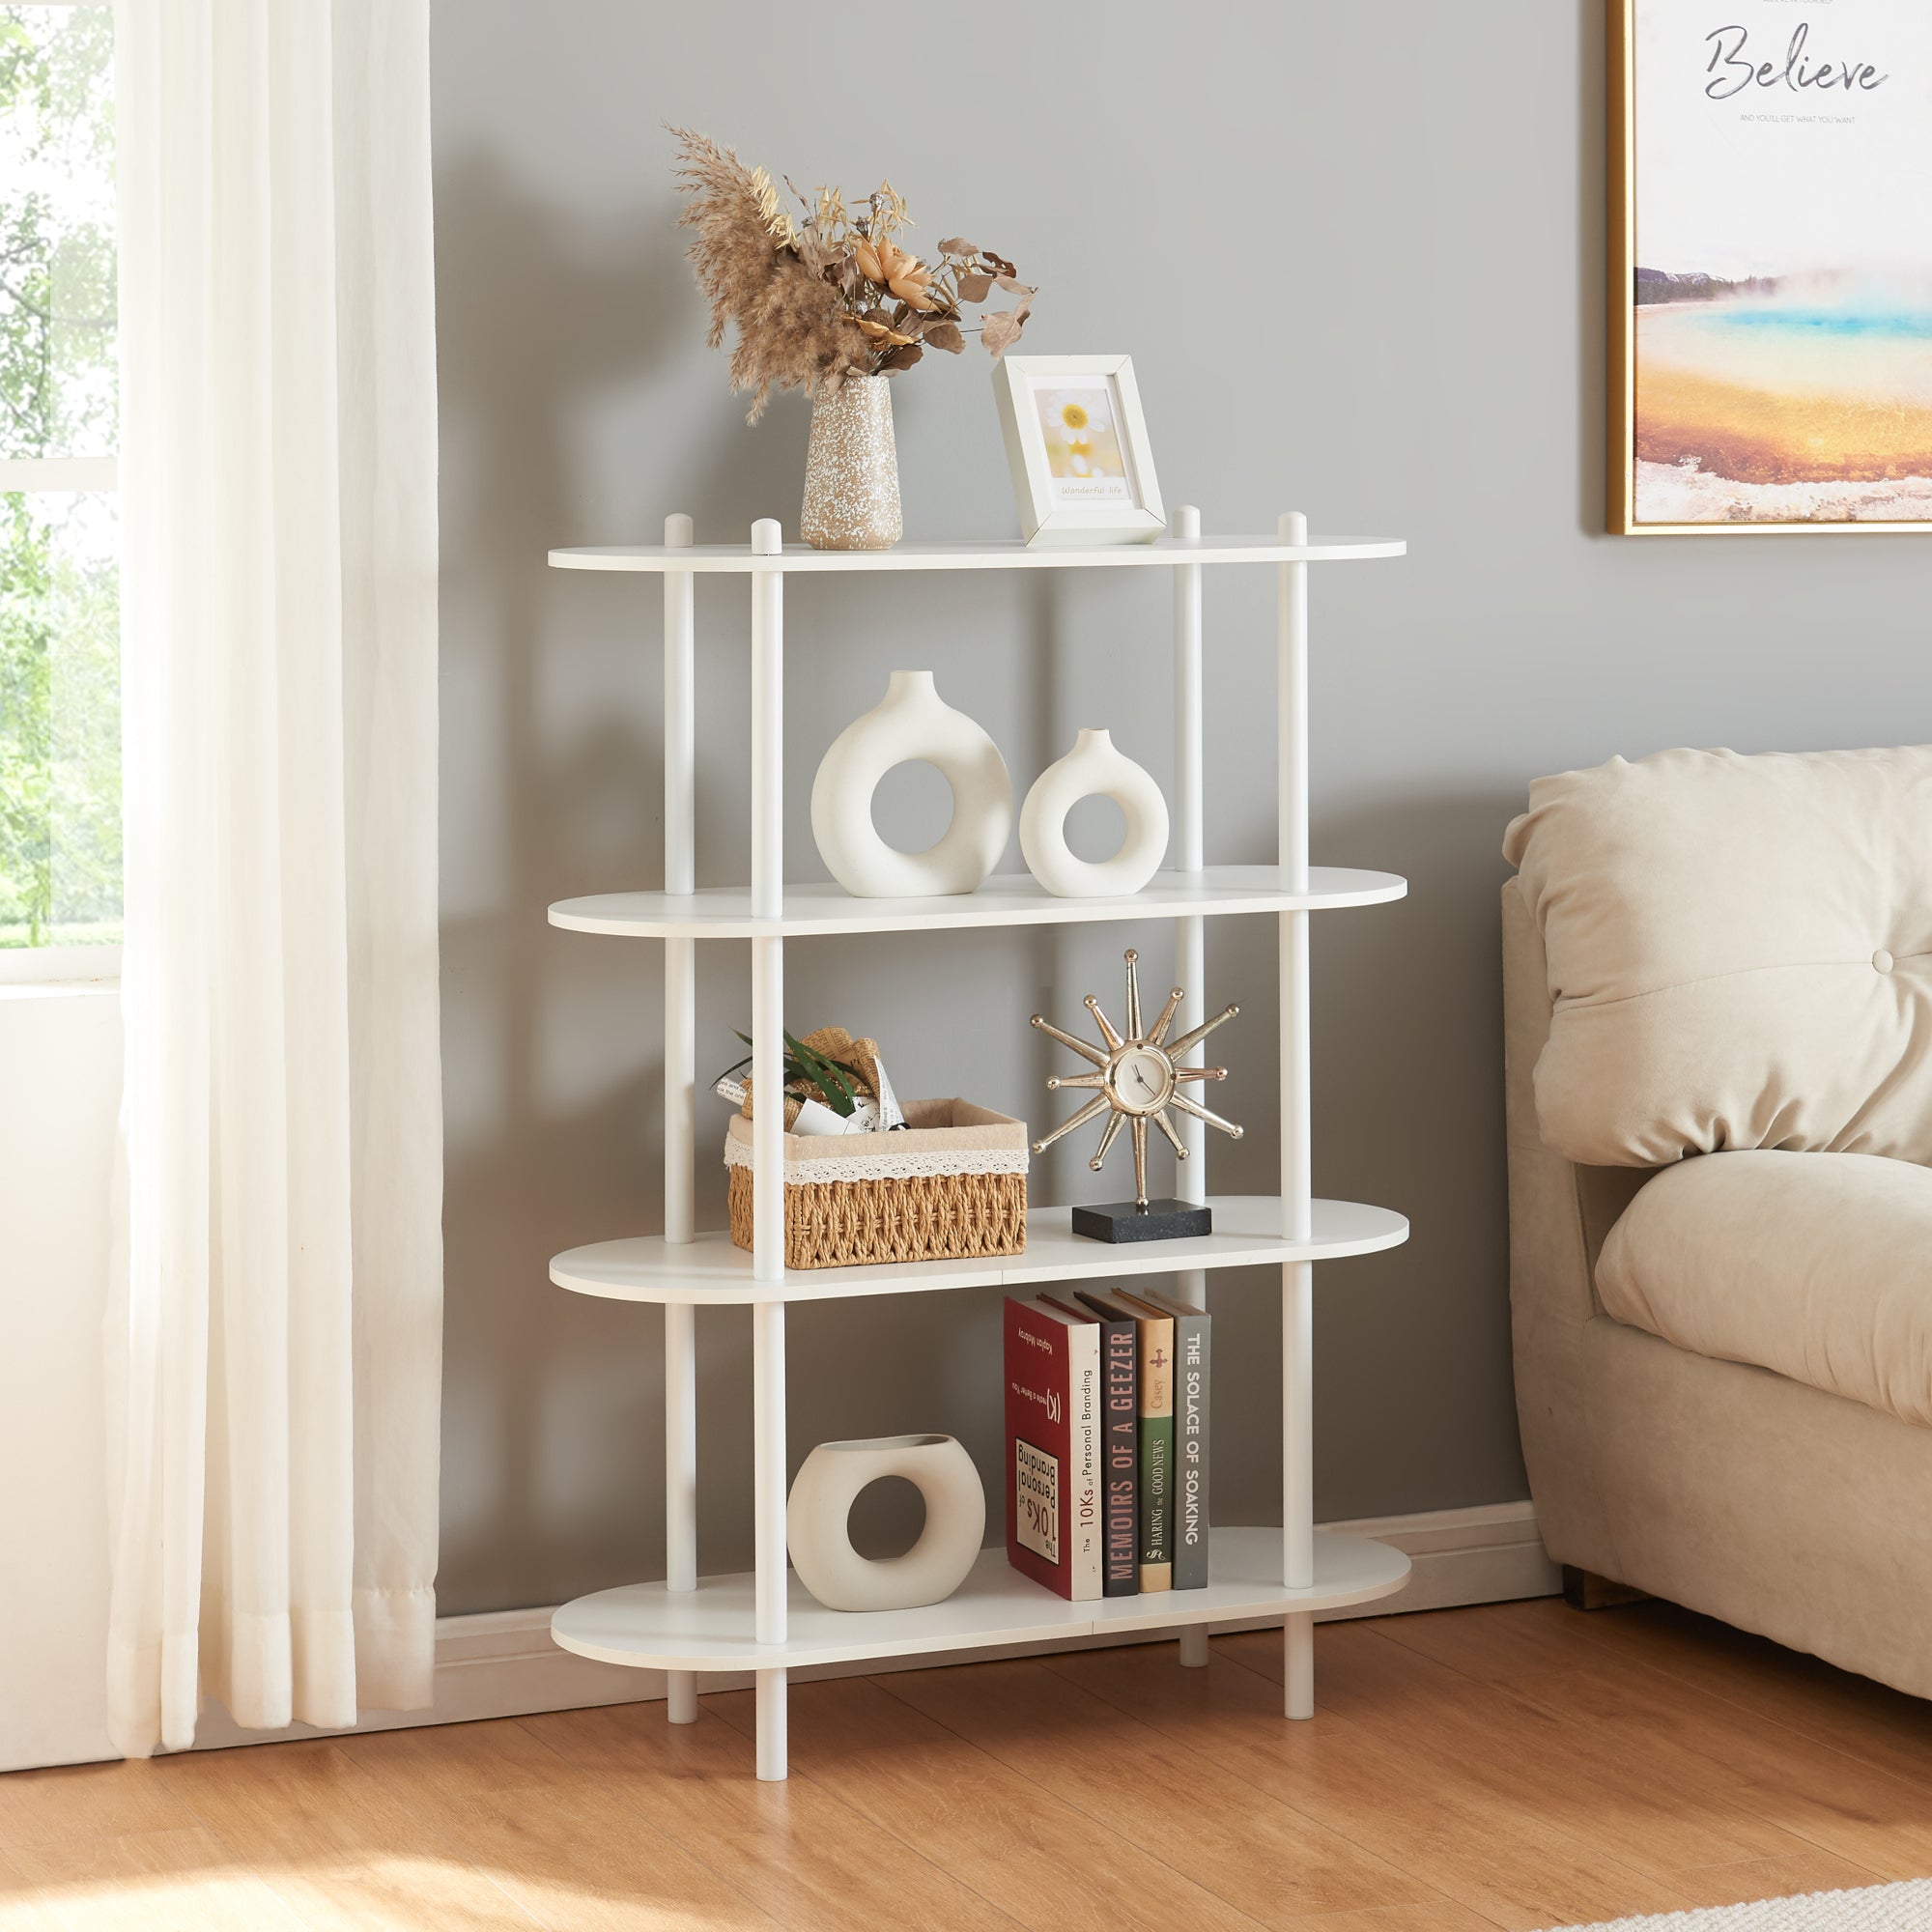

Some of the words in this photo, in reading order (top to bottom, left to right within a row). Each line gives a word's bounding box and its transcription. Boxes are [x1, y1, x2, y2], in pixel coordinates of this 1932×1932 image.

[1705, 22, 1889, 99] Believe
[1796, 115, 1816, 124] WHAT
[1062, 486, 1104, 495] Wonderful
[1109, 486, 1122, 495] life
[1037, 1338, 1053, 1355] Kaplan
[1186, 1333, 1200, 1365] THE
[1110, 1333, 1133, 1410] GEEZER
[1011, 1382, 1020, 1395] You
[1020, 1386, 1033, 1401] Better
[1081, 1370, 1093, 1420] Branding
[1151, 1379, 1166, 1408] Casey
[1186, 1372, 1200, 1435] SOLACE
[1112, 1422, 1133, 1434] A
[1018, 1444, 1056, 1486] Branding
[1081, 1425, 1092, 1476] Personal
[1112, 1444, 1133, 1468] OF
[1152, 1439, 1164, 1466] NEWS
[1185, 1441, 1199, 1463] OF
[1018, 1469, 1056, 1509] Personal
[1151, 1467, 1164, 1494] GOOD
[1019, 1495, 1025, 1507] of
[1080, 1489, 1094, 1527] 10Ks
[1185, 1469, 1199, 1546] SOAKING
[1027, 1498, 1057, 1542] 10Ks
[1110, 1480, 1133, 1579] MEMOIRS
[1045, 1540, 1056, 1557] The
